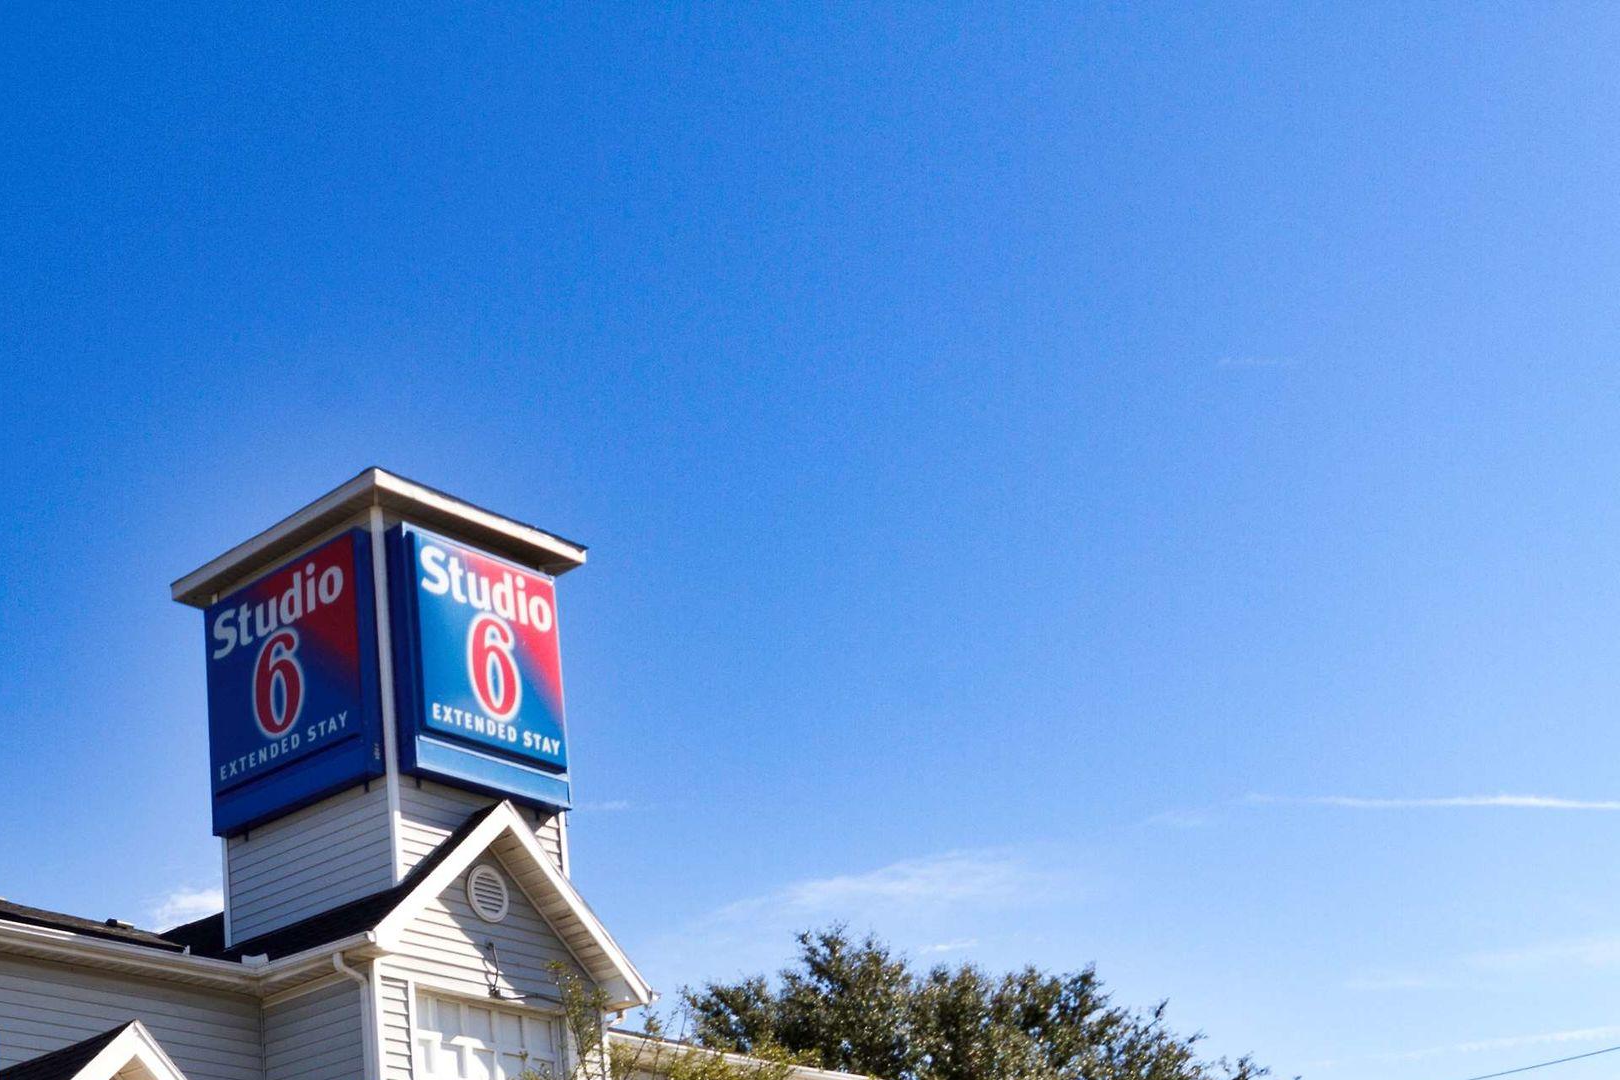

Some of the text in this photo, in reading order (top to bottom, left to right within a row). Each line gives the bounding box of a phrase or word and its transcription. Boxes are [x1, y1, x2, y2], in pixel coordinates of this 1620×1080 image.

[213, 562, 343, 660] Studio
[420, 545, 552, 633] Studio
[252, 626, 305, 739] 6
[467, 611, 523, 723] 6
[220, 710, 348, 781] EXTENDED STAY
[432, 702, 561, 756] EXTENDED STAY
